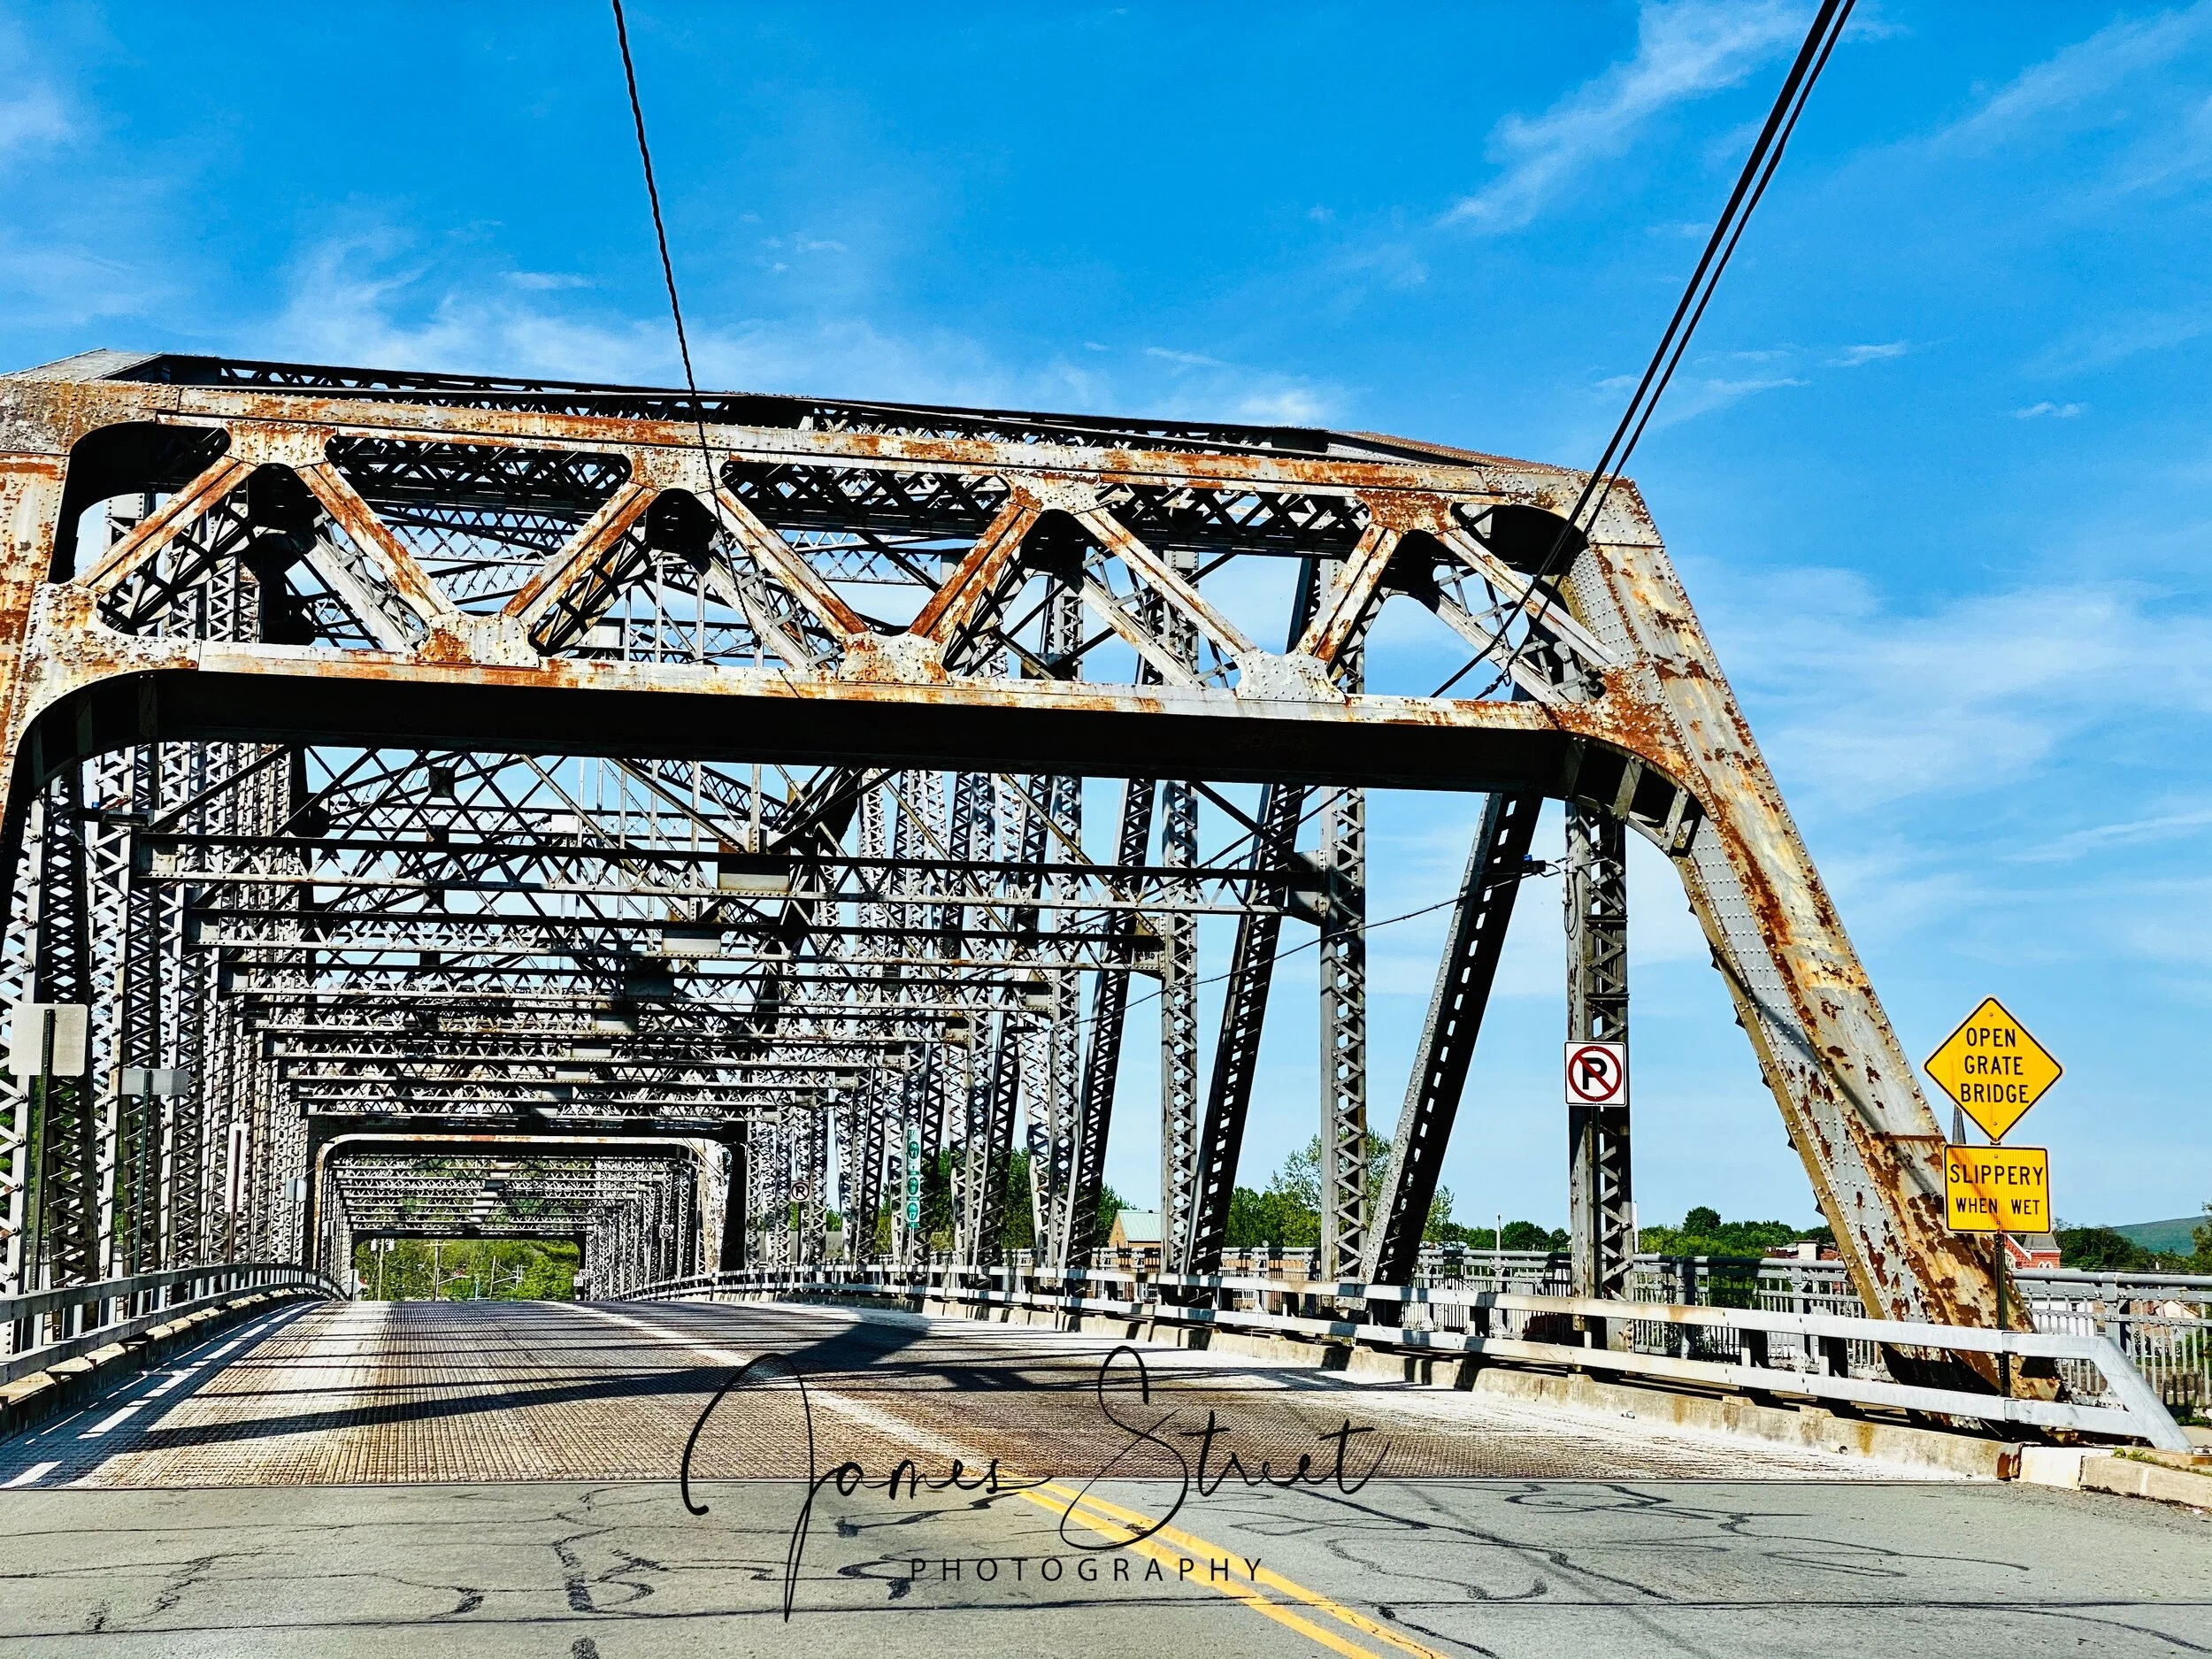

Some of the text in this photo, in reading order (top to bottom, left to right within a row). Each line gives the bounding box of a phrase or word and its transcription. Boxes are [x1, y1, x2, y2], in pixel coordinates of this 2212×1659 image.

[1965, 1027, 2016, 1048] OPEN
[1580, 1056, 1608, 1090] P
[1964, 1056, 2024, 1076] GRATE
[1960, 1083, 2030, 1103] BRIDGE
[1949, 1164, 2043, 1186] SLIPPERY
[1955, 1197, 2040, 1215] WHEN WET
